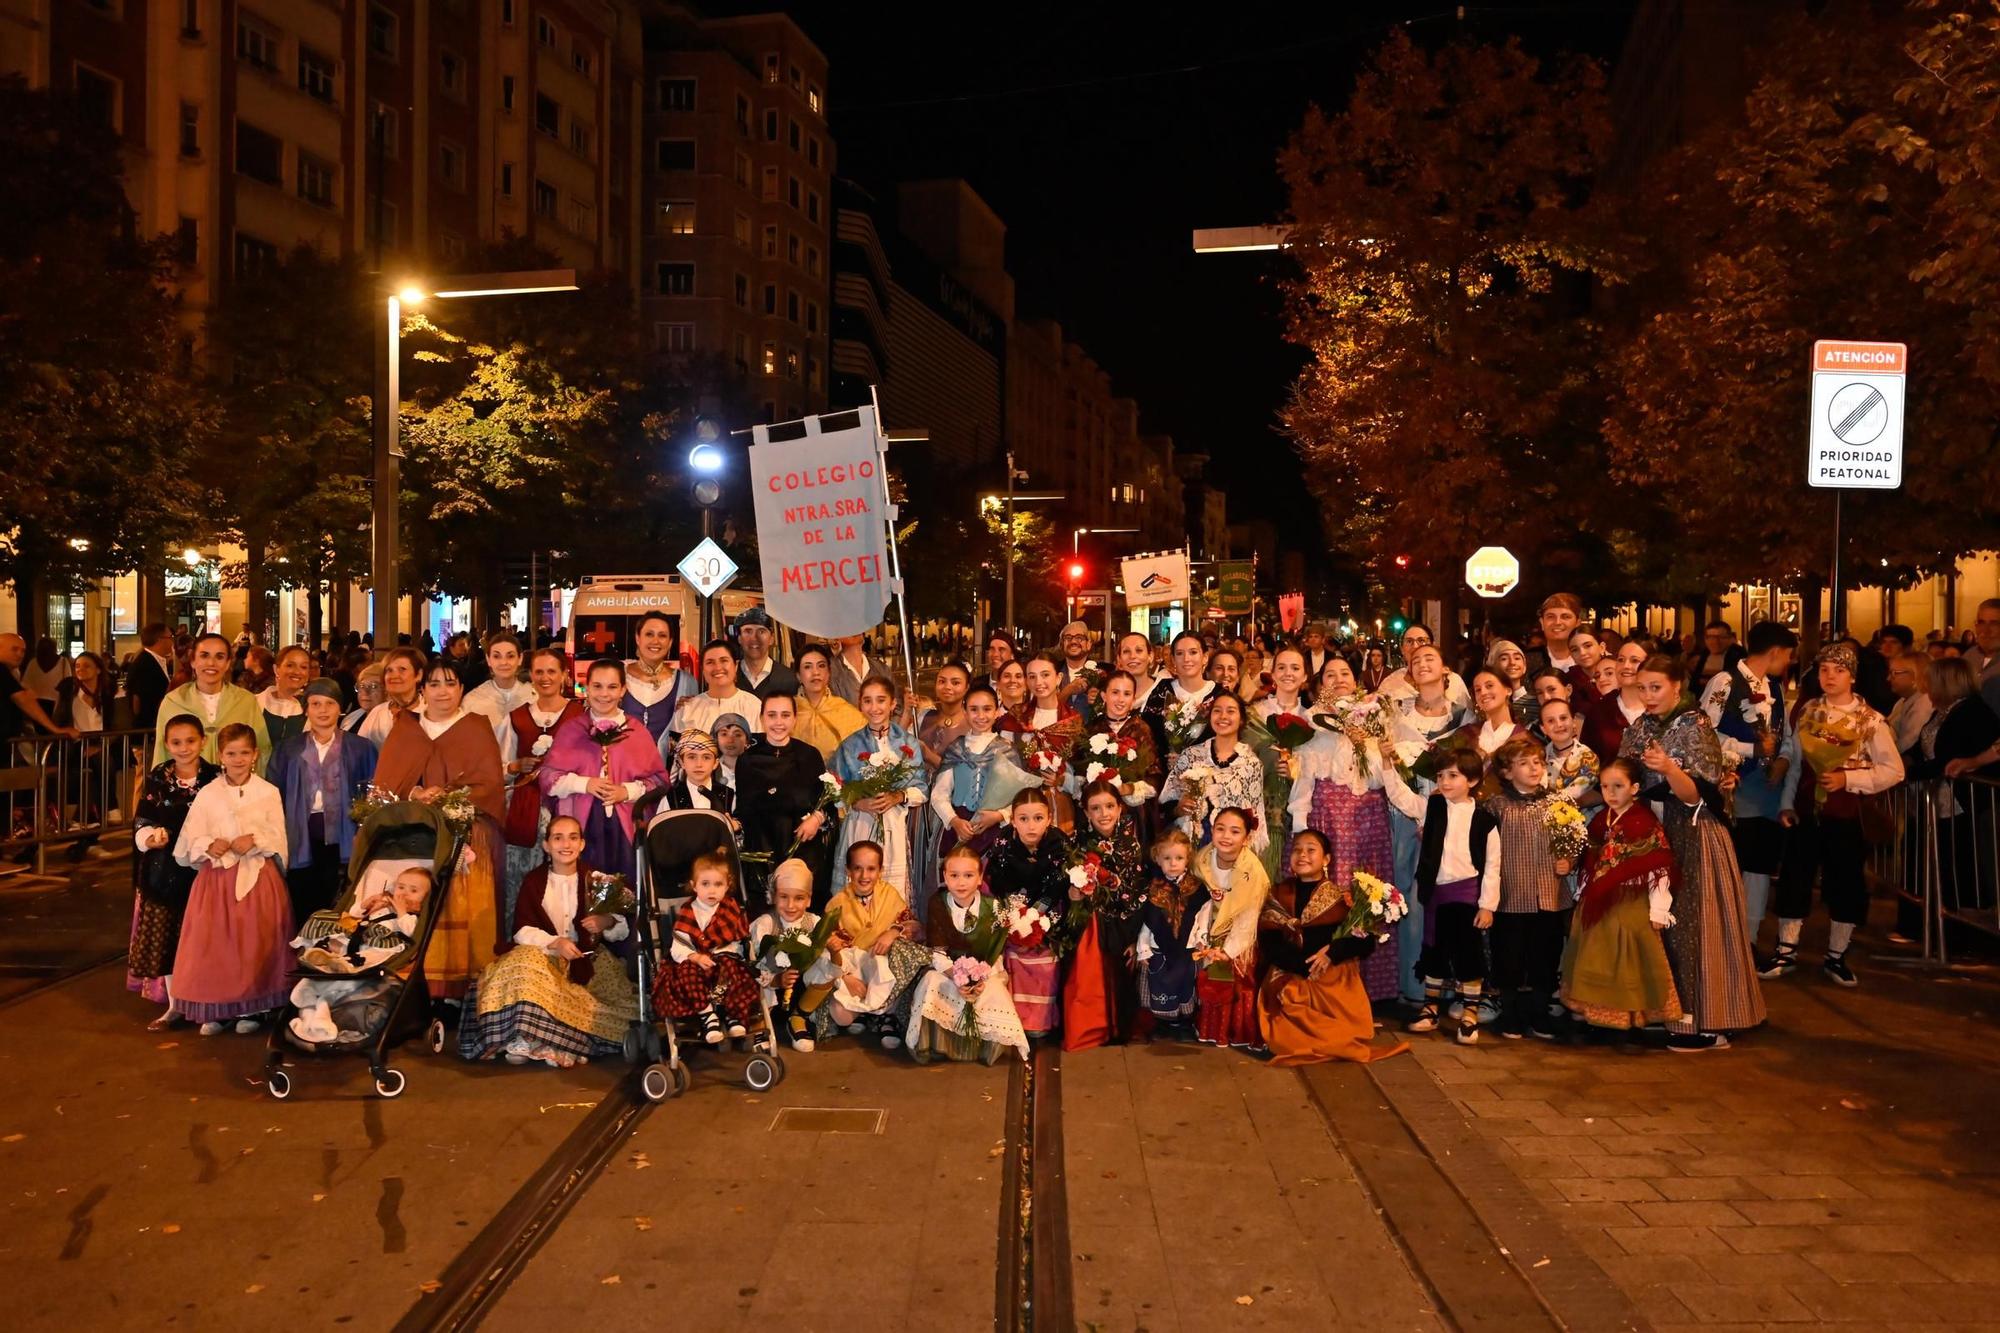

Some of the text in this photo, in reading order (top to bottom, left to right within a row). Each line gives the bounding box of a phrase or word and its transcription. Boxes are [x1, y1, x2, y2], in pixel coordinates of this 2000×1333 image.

[1825, 351, 1896, 364] ATENCIÓN
[1820, 450, 1893, 462] PRIORIDAD
[769, 461, 874, 493] COLEGIO
[1820, 467, 1891, 479] PEATONAL
[803, 525, 855, 545] DE LA
[694, 557, 720, 577] 30
[587, 595, 670, 607] AMBULANCIA
